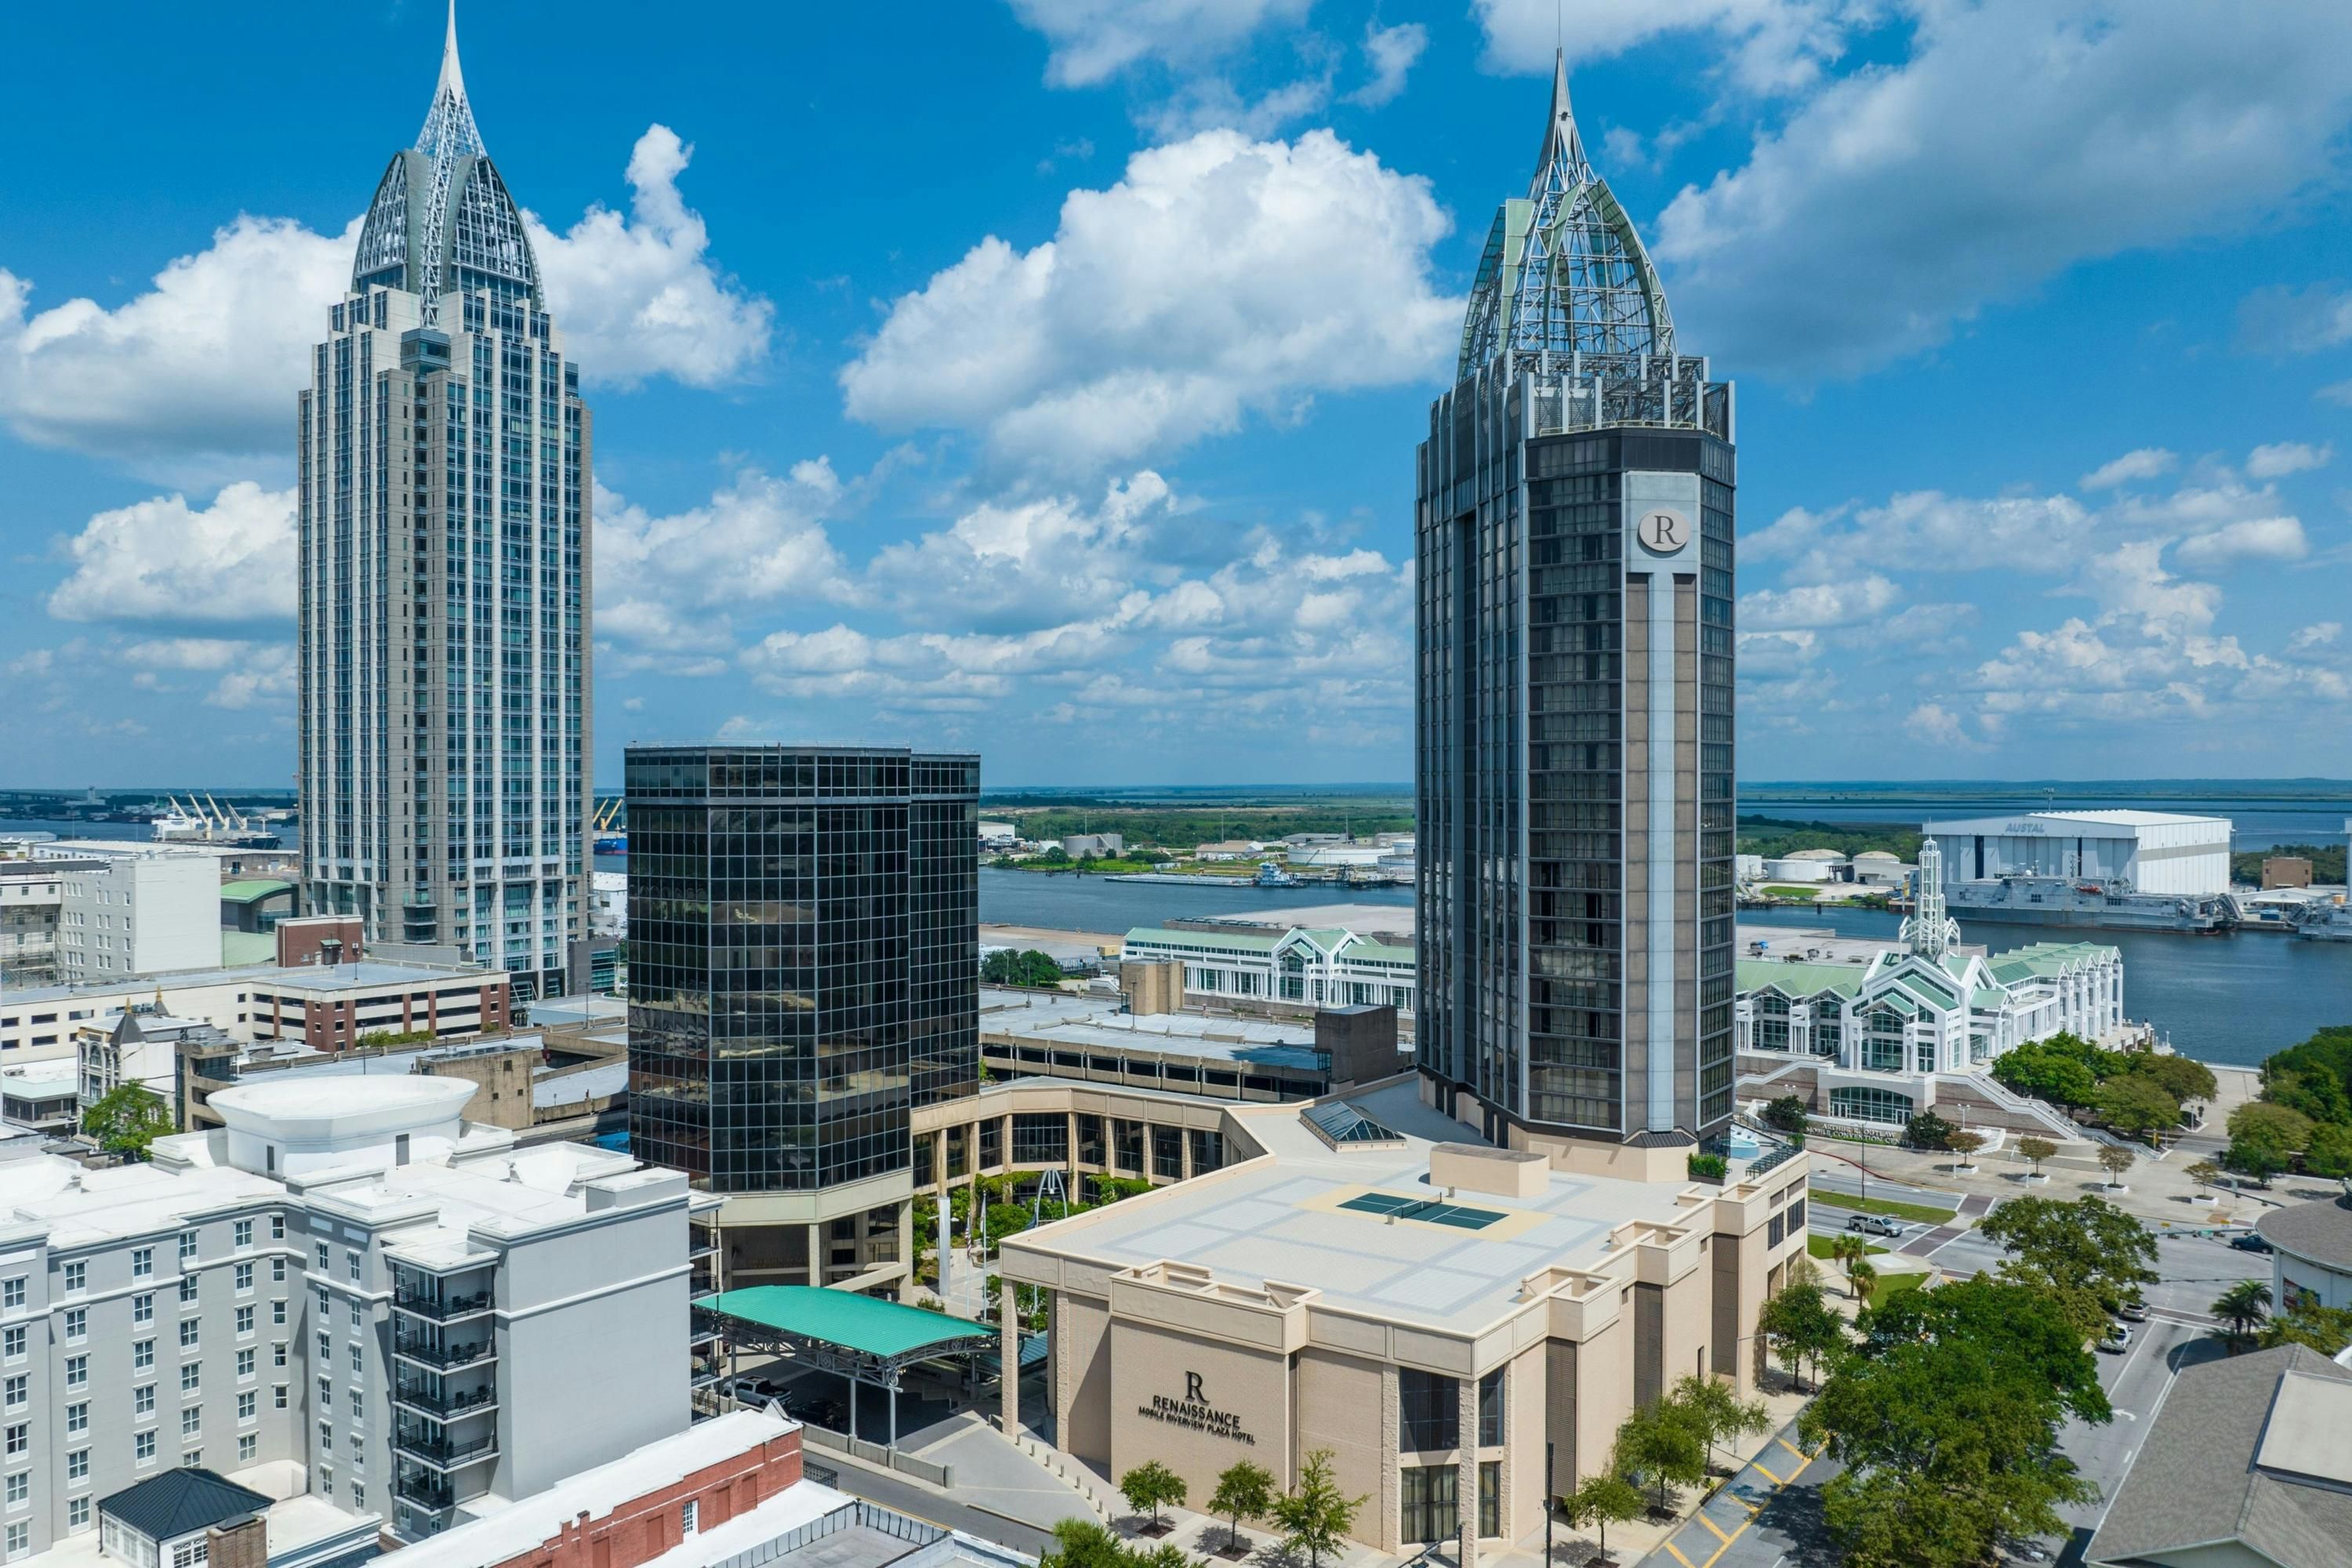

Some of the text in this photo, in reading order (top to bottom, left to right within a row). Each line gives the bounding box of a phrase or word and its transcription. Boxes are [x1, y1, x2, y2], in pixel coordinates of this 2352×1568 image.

[1653, 515, 1683, 545] R
[2005, 822, 2045, 833] AUSTAL
[1833, 1131, 1882, 1142] CONVENTION
[1864, 1129, 1895, 1138] OUTLAW
[1185, 1370, 1209, 1403] R
[1138, 1406, 1255, 1444] MOBILE RIVERVIEW PLAZA HOTEL
[1153, 1395, 1240, 1429] RENAISSANCE
